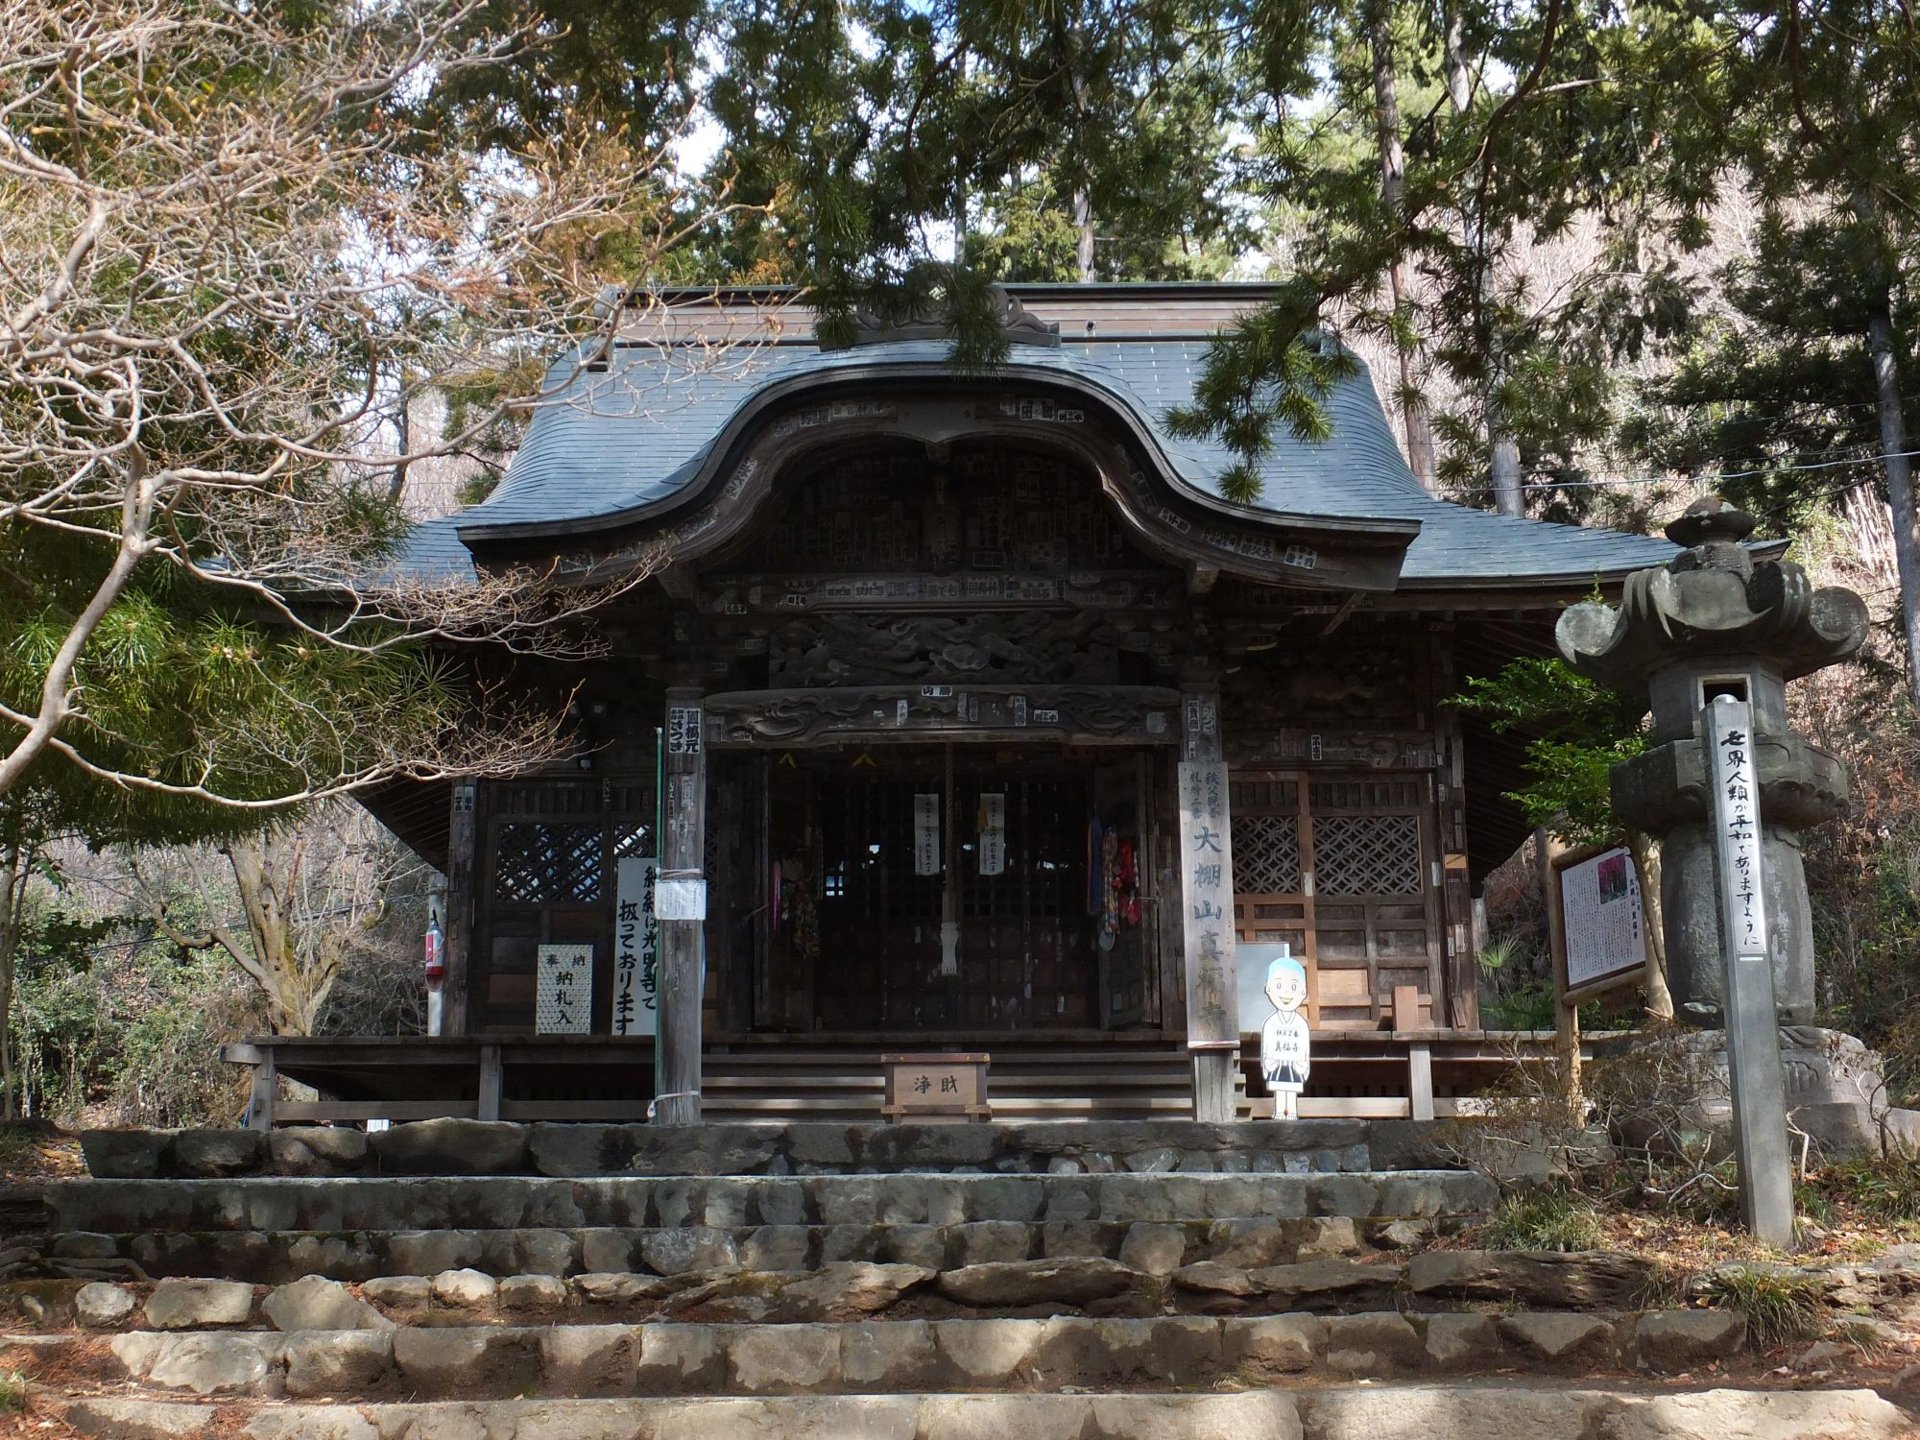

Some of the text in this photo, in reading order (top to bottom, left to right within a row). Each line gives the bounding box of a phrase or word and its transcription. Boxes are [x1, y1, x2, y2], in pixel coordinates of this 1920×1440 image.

[1720, 730, 1760, 946] 世界人類が平和でありますように
[555, 971, 573, 1024] 納札入
[615, 899, 640, 1035] 扱っております
[914, 1074, 958, 1094] 浄財
